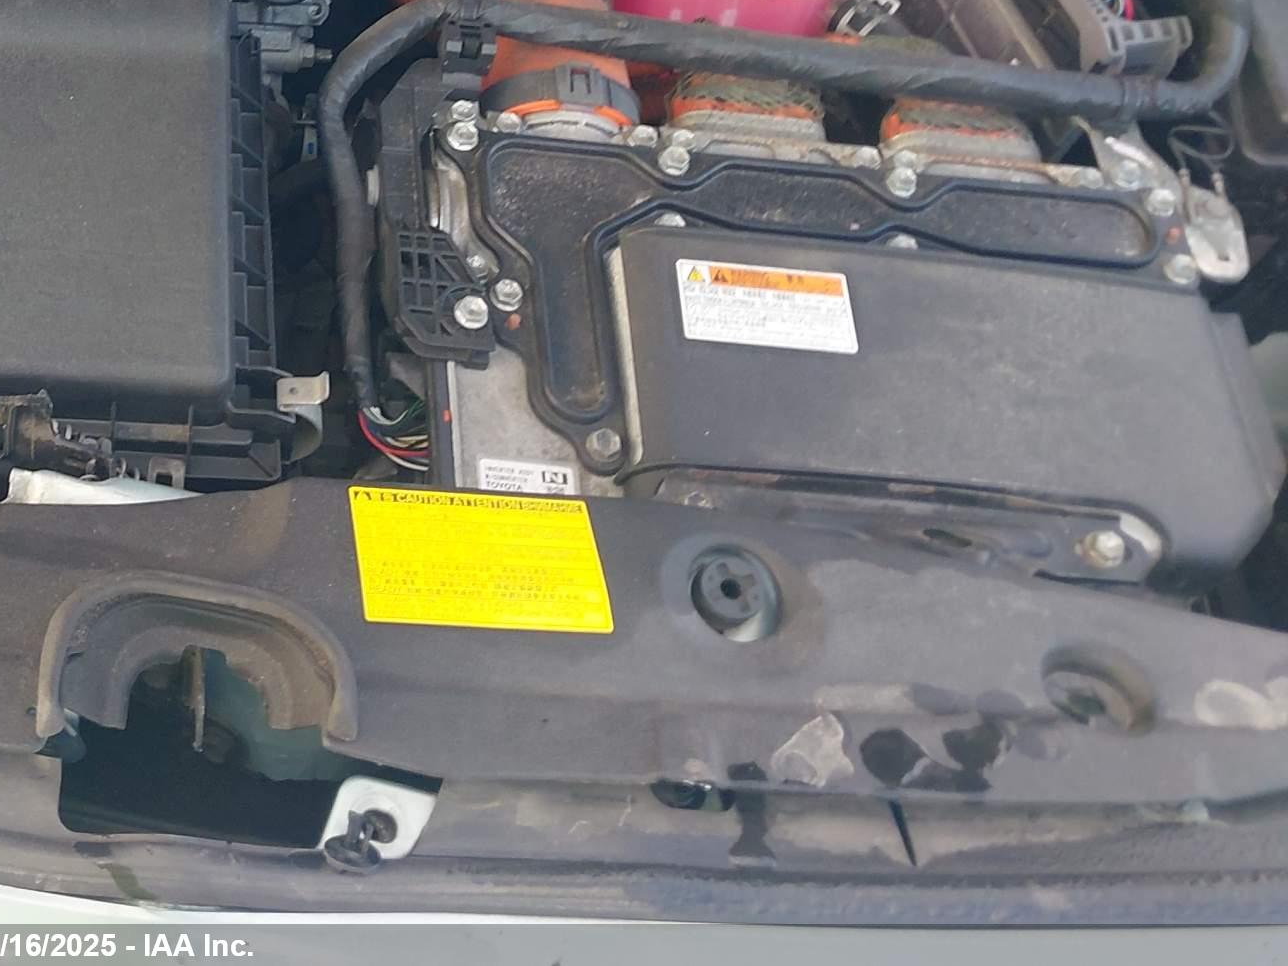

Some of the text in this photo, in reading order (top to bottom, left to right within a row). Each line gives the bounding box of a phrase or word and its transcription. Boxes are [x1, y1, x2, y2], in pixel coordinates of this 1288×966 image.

[486, 481, 522, 490] TOYOTA
[399, 493, 451, 506] CAUTION
[454, 496, 521, 509] ATTENTION
